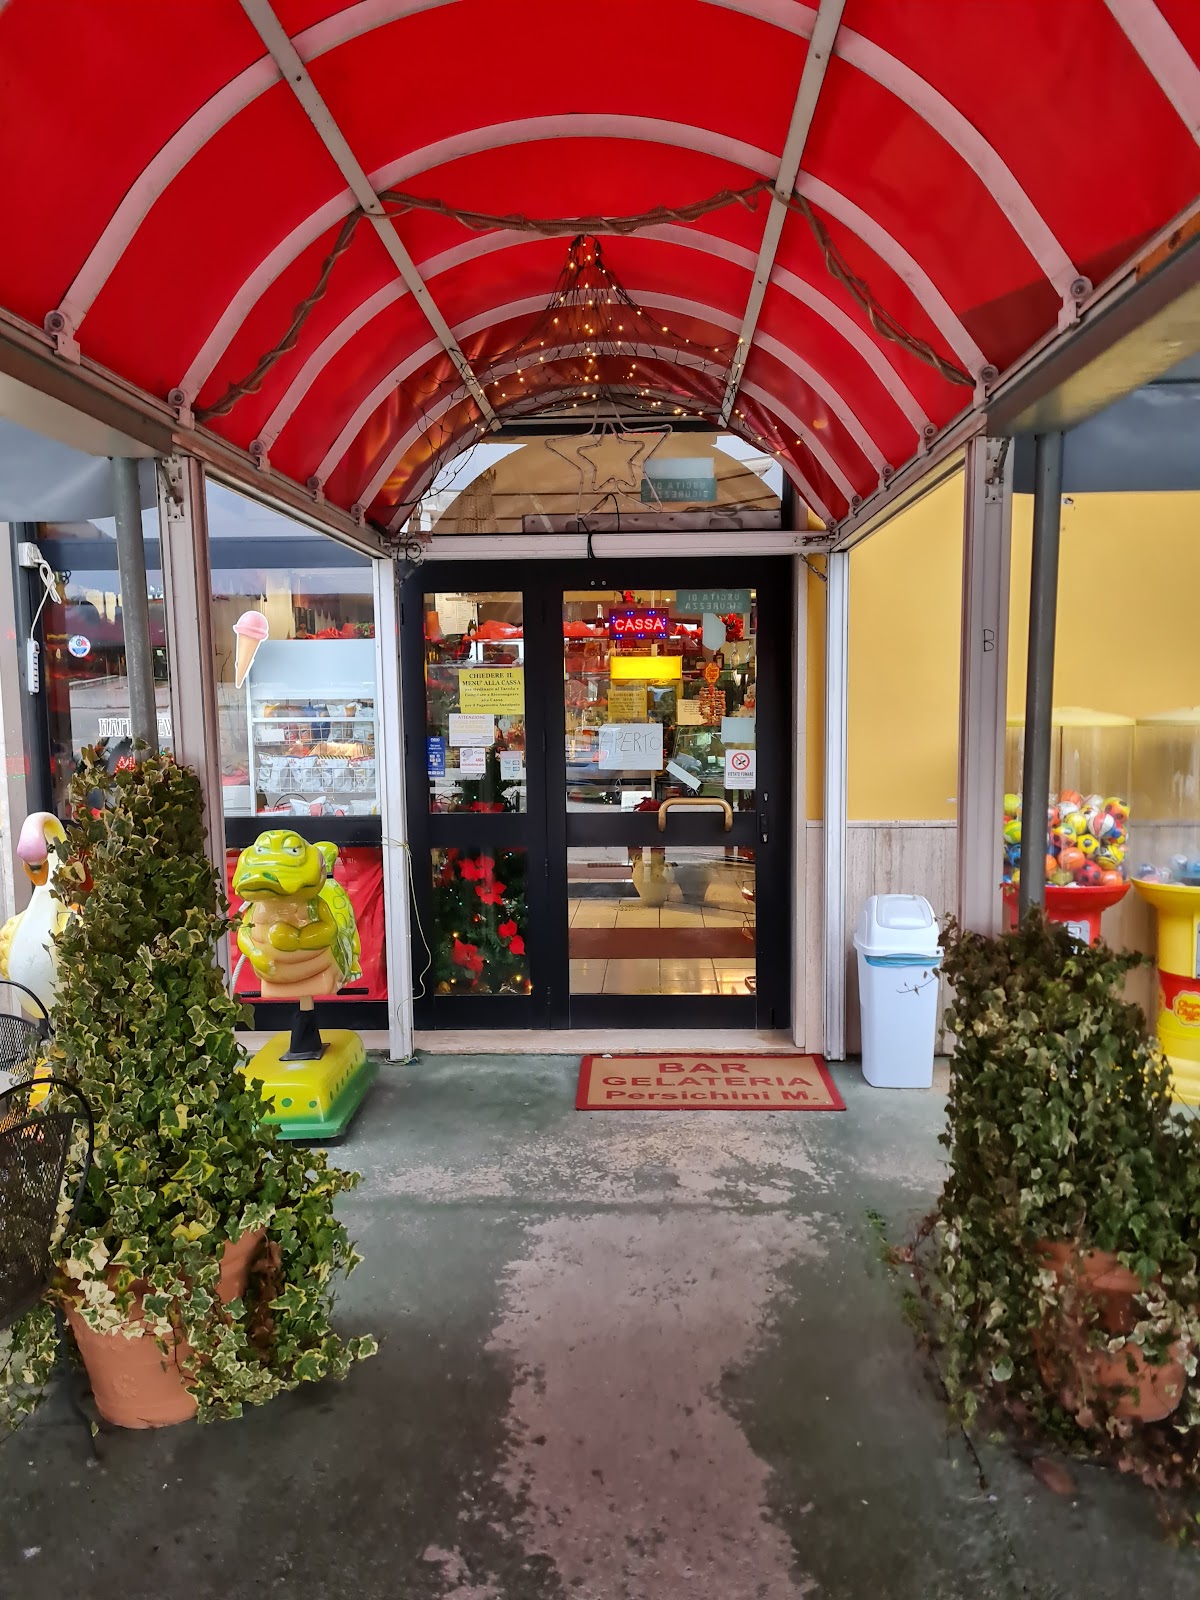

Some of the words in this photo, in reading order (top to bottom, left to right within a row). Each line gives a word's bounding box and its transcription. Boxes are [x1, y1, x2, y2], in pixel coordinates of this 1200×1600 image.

[614, 618, 665, 631] CASSA
[600, 729, 662, 753] APERTO
[658, 1062, 751, 1074] BAR
[602, 1076, 814, 1087] GELATERIA
[606, 1090, 769, 1100] Persichini
[781, 1090, 819, 1101] M.
